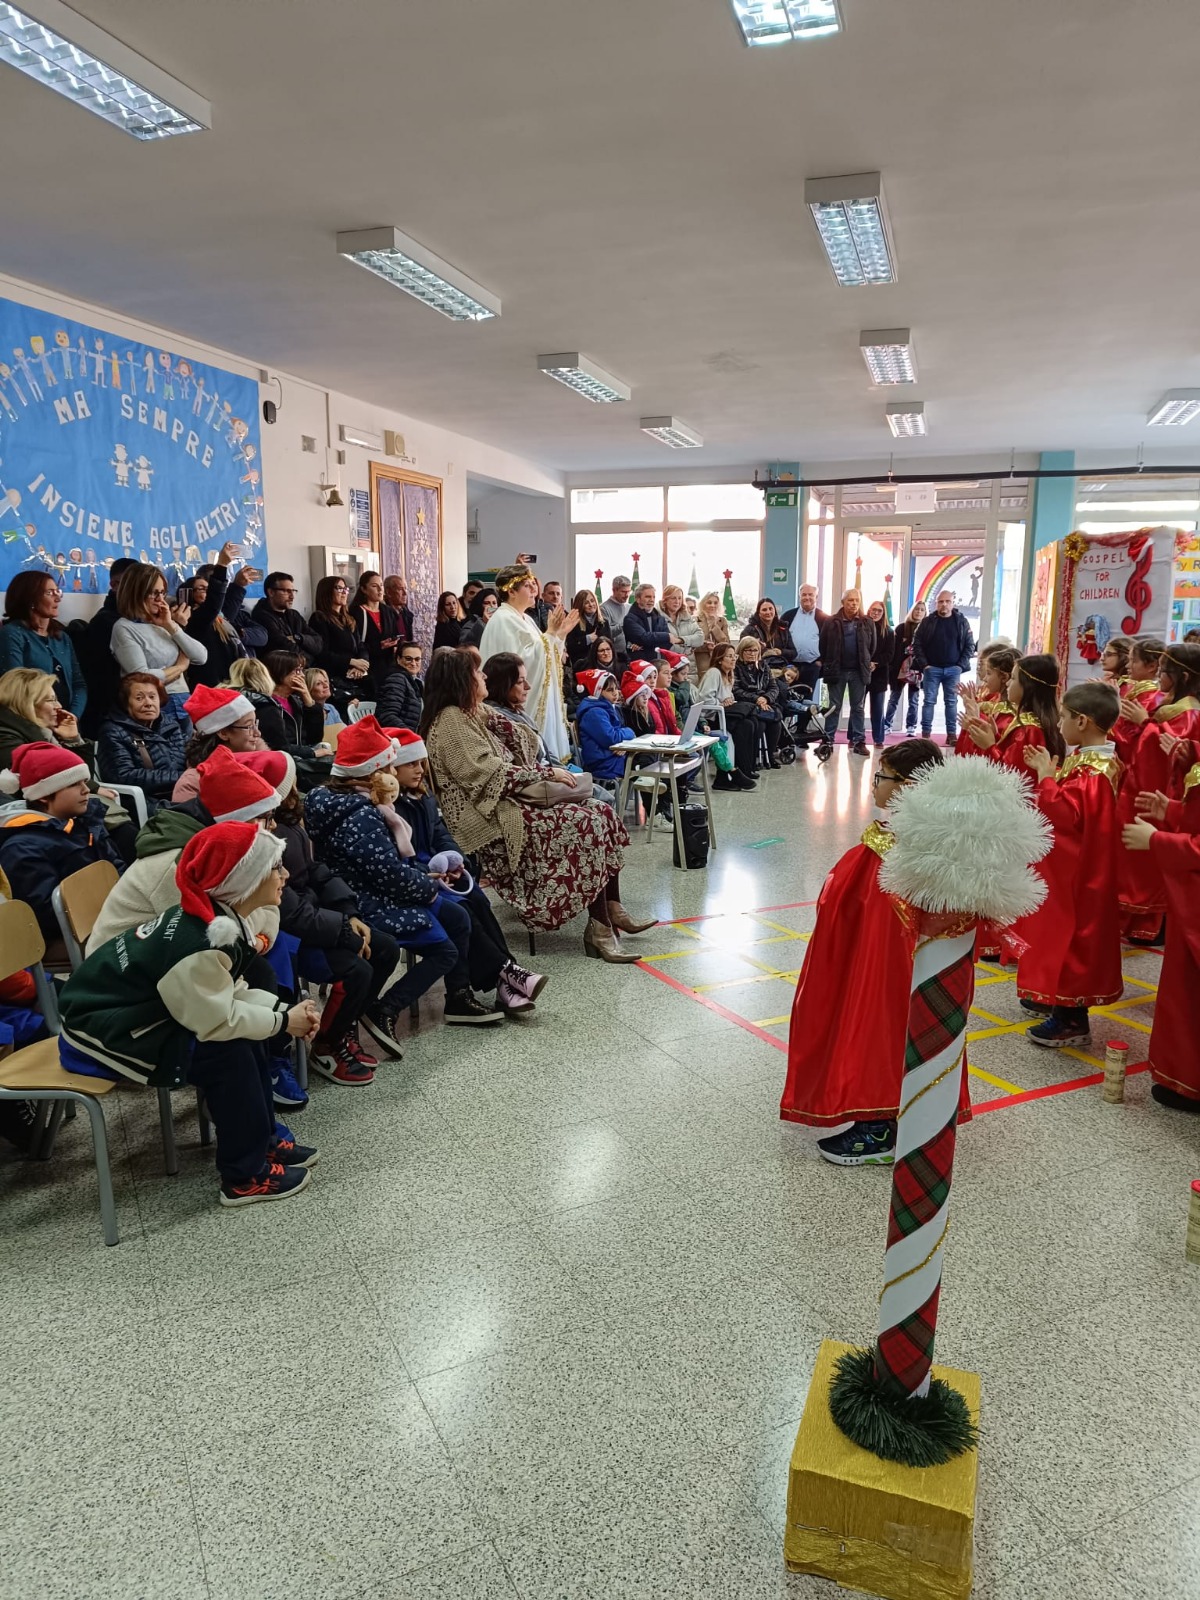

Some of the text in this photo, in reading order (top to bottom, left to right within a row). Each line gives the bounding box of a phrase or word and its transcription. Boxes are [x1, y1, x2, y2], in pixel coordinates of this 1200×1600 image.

[53, 390, 215, 469] MA SEMPRE
[27, 473, 241, 549] INSIEME AGLI ALTRI
[1083, 553, 1125, 565] GOSPEL
[1095, 571, 1110, 582] FOR
[1079, 588, 1120, 601] CHILDREN
